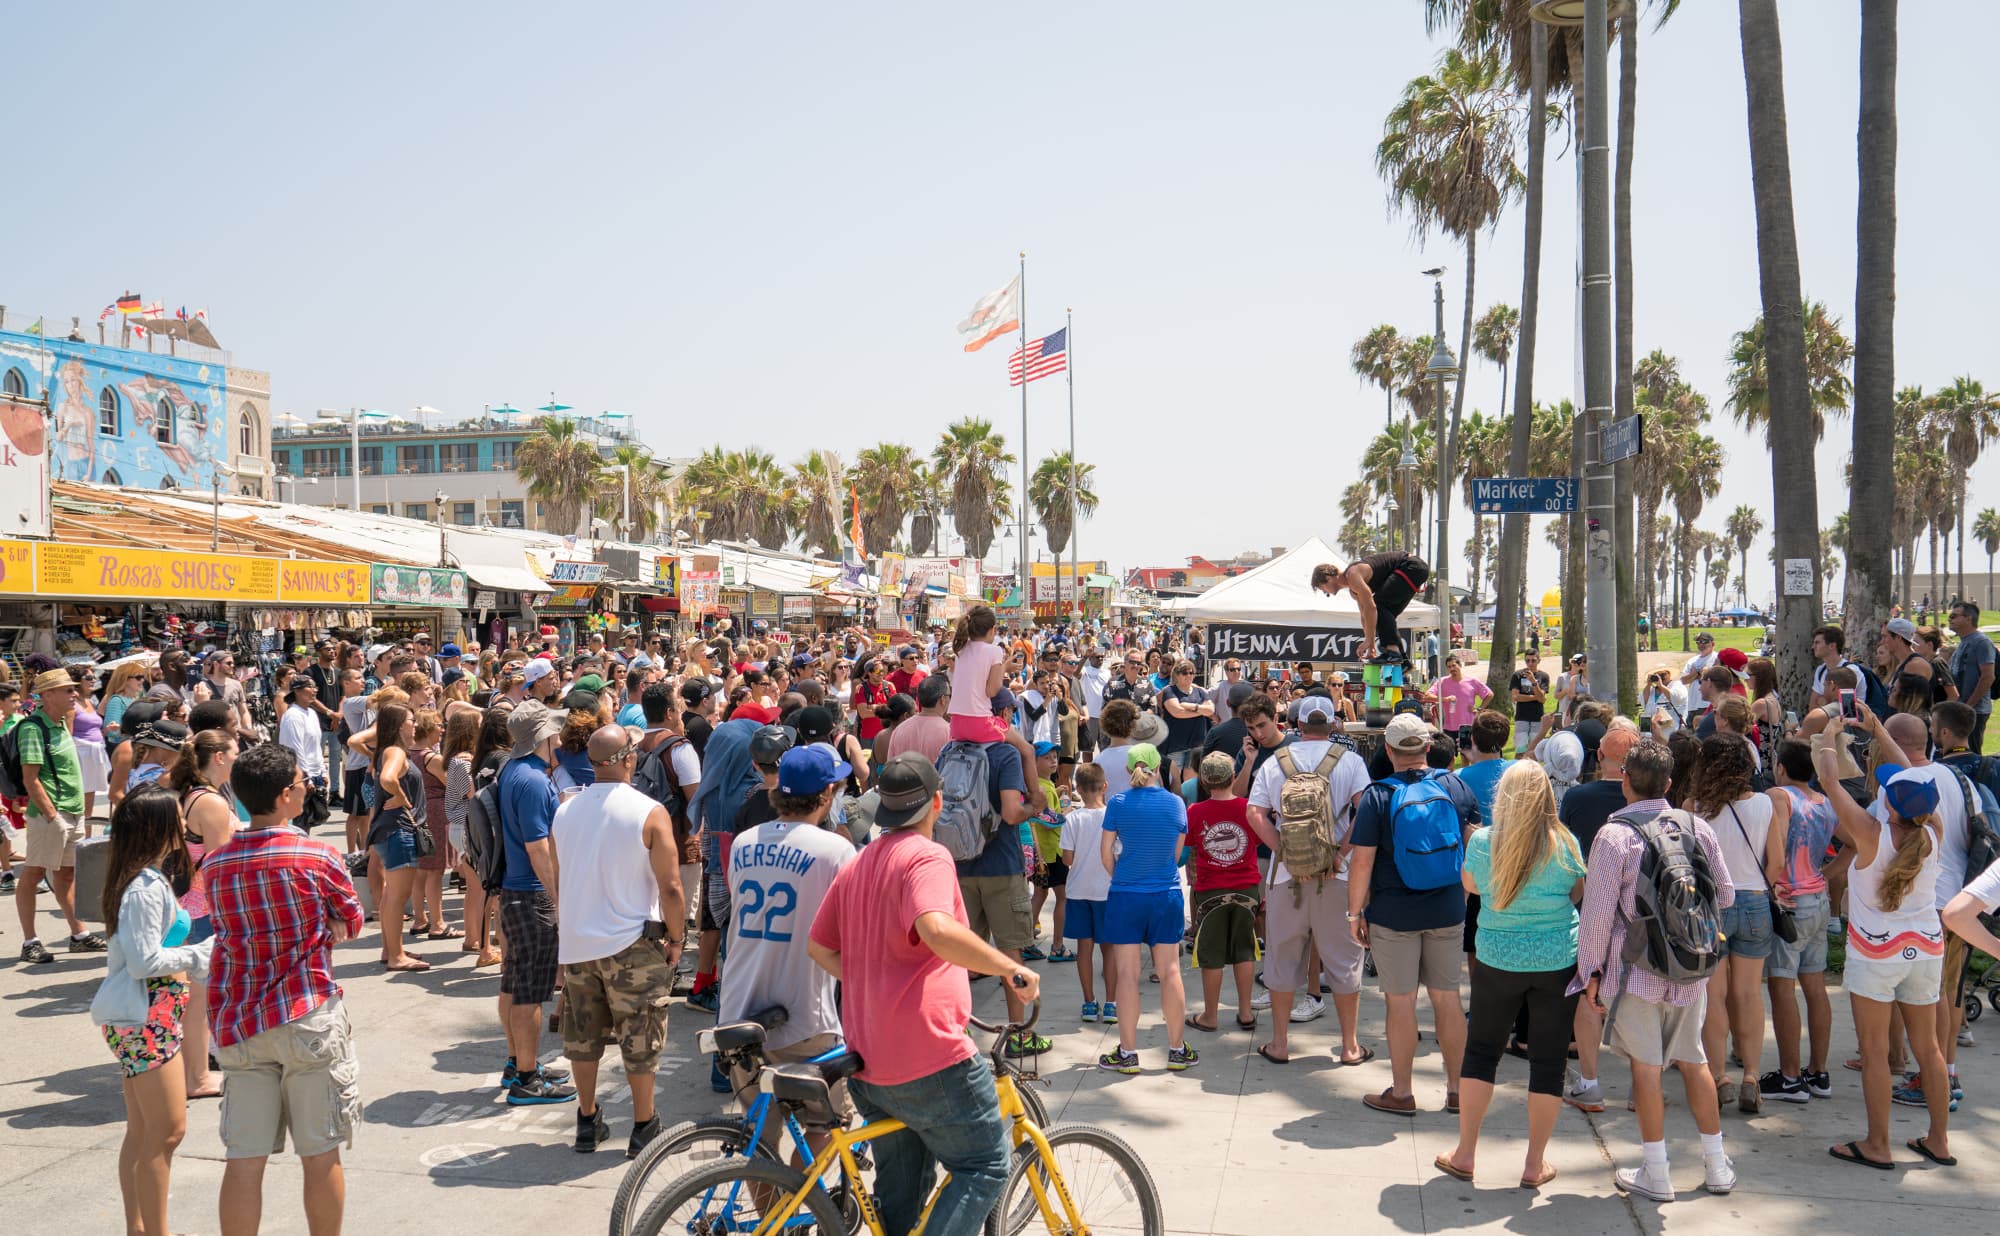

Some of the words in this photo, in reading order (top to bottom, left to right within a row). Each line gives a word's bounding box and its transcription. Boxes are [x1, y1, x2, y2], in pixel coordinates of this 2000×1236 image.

[1478, 481, 1536, 499] Market
[1555, 480, 1573, 498] St
[1545, 498, 1560, 511] 00
[1566, 498, 1574, 511] E
[171, 560, 232, 591] SHOES
[283, 569, 341, 592] SANDALS
[551, 563, 579, 580] SOCKS
[770, 634, 788, 643] ATM
[1213, 629, 1300, 657] HENNA
[734, 843, 816, 877] KERSHAW
[738, 879, 797, 942] 22
